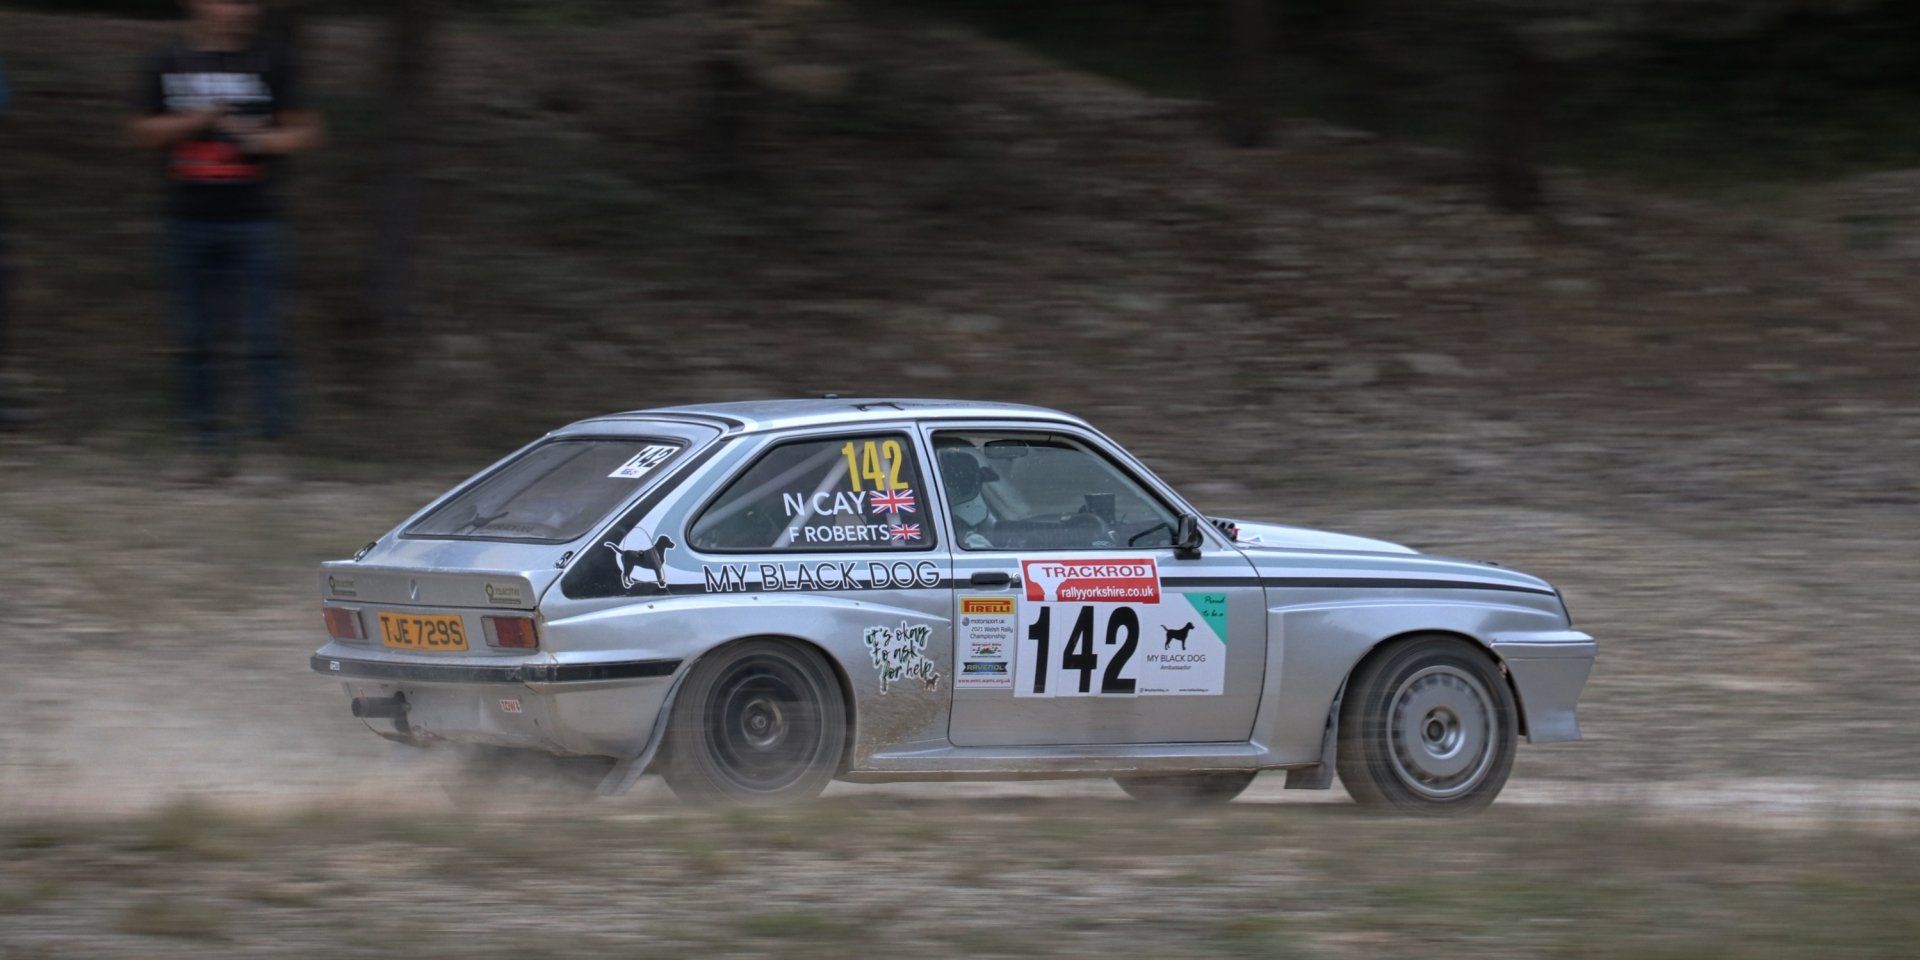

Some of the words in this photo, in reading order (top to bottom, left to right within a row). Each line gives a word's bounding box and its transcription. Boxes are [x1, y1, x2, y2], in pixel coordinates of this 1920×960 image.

[627, 447, 675, 467] 142
[842, 440, 909, 492] 142
[782, 492, 806, 516] N
[812, 491, 867, 515] CAY
[788, 526, 800, 542] F
[804, 524, 890, 542] ROBERTS
[702, 563, 749, 593] MY
[759, 560, 863, 591] BLACK
[867, 560, 940, 588] DOG
[1041, 565, 1146, 578] TRACKROD
[1061, 586, 1154, 600] rallyyorkshire.co.uk
[964, 600, 1011, 613] PIRELLI
[381, 616, 414, 645] TJE
[413, 619, 465, 646] 729S
[896, 622, 930, 647] okay
[1028, 605, 1140, 694] 142
[883, 661, 902, 692] for
[906, 658, 932, 680] help
